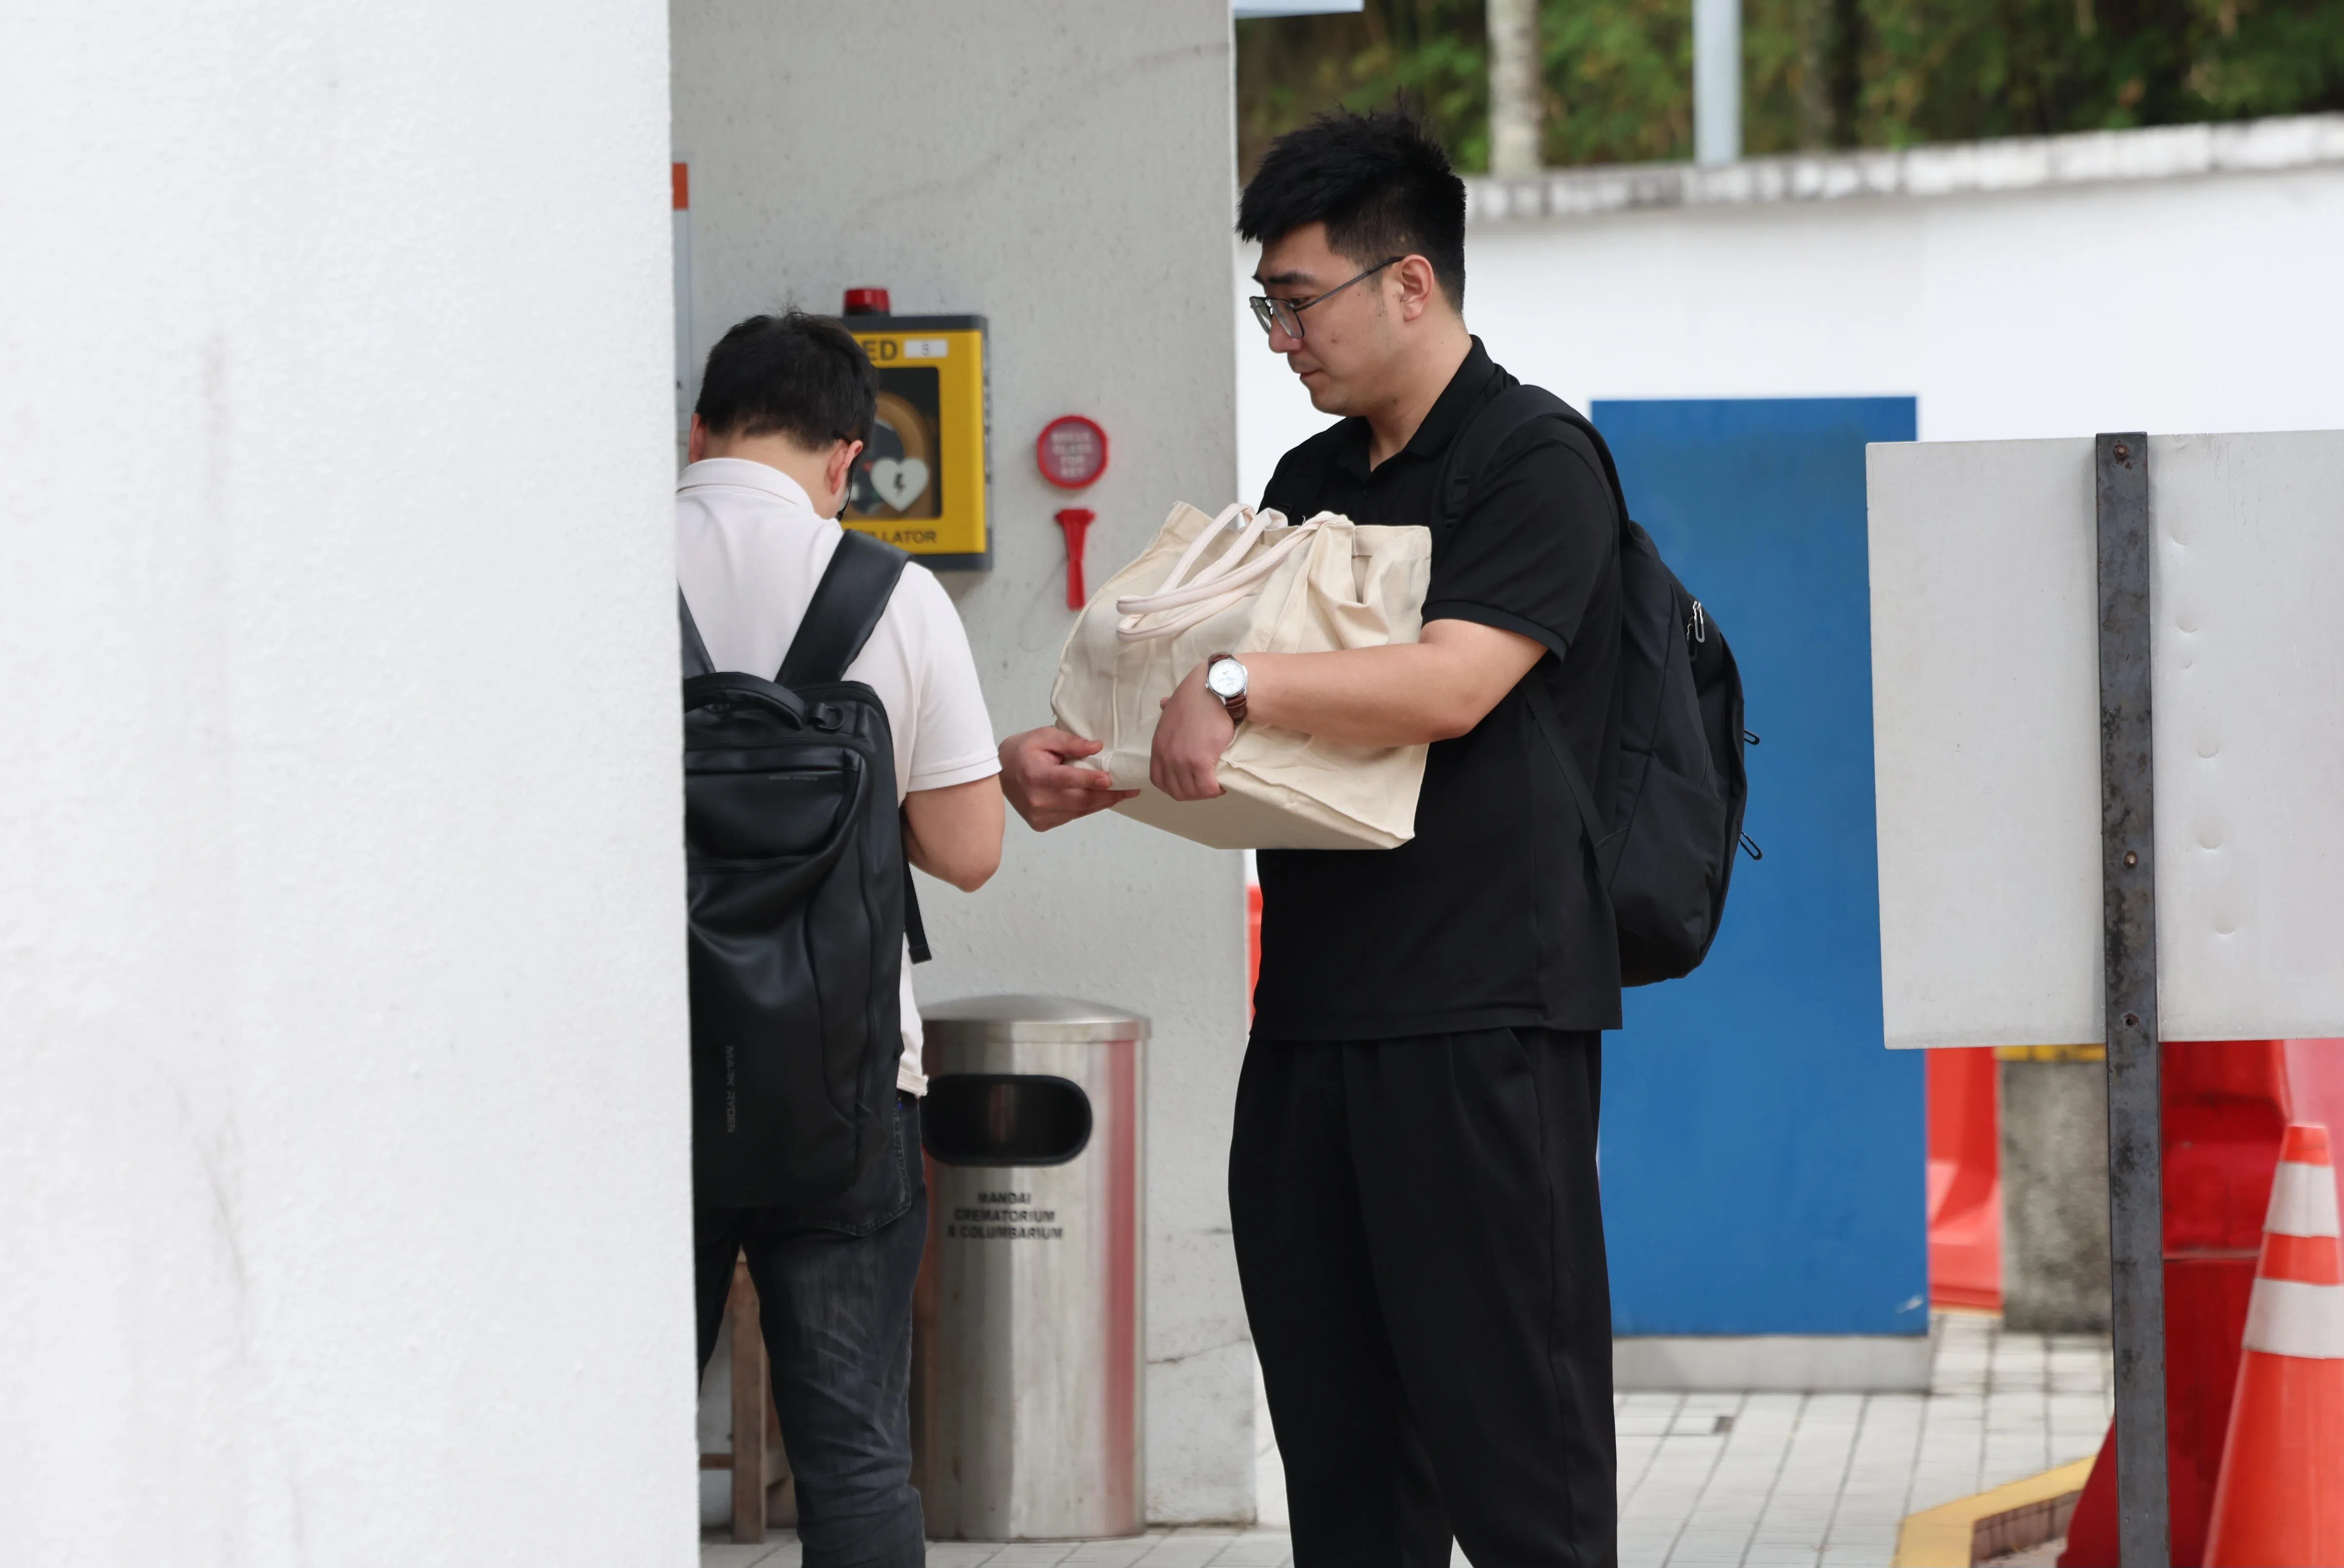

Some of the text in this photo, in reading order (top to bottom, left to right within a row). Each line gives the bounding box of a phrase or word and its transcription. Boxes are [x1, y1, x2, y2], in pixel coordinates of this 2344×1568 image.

[726, 1045, 736, 1133] MARK RYDEN
[978, 1192, 1032, 1204] MANDAI
[954, 1208, 1055, 1222] CREMATORIUM
[959, 1225, 1063, 1239] COLUMBARIUM
